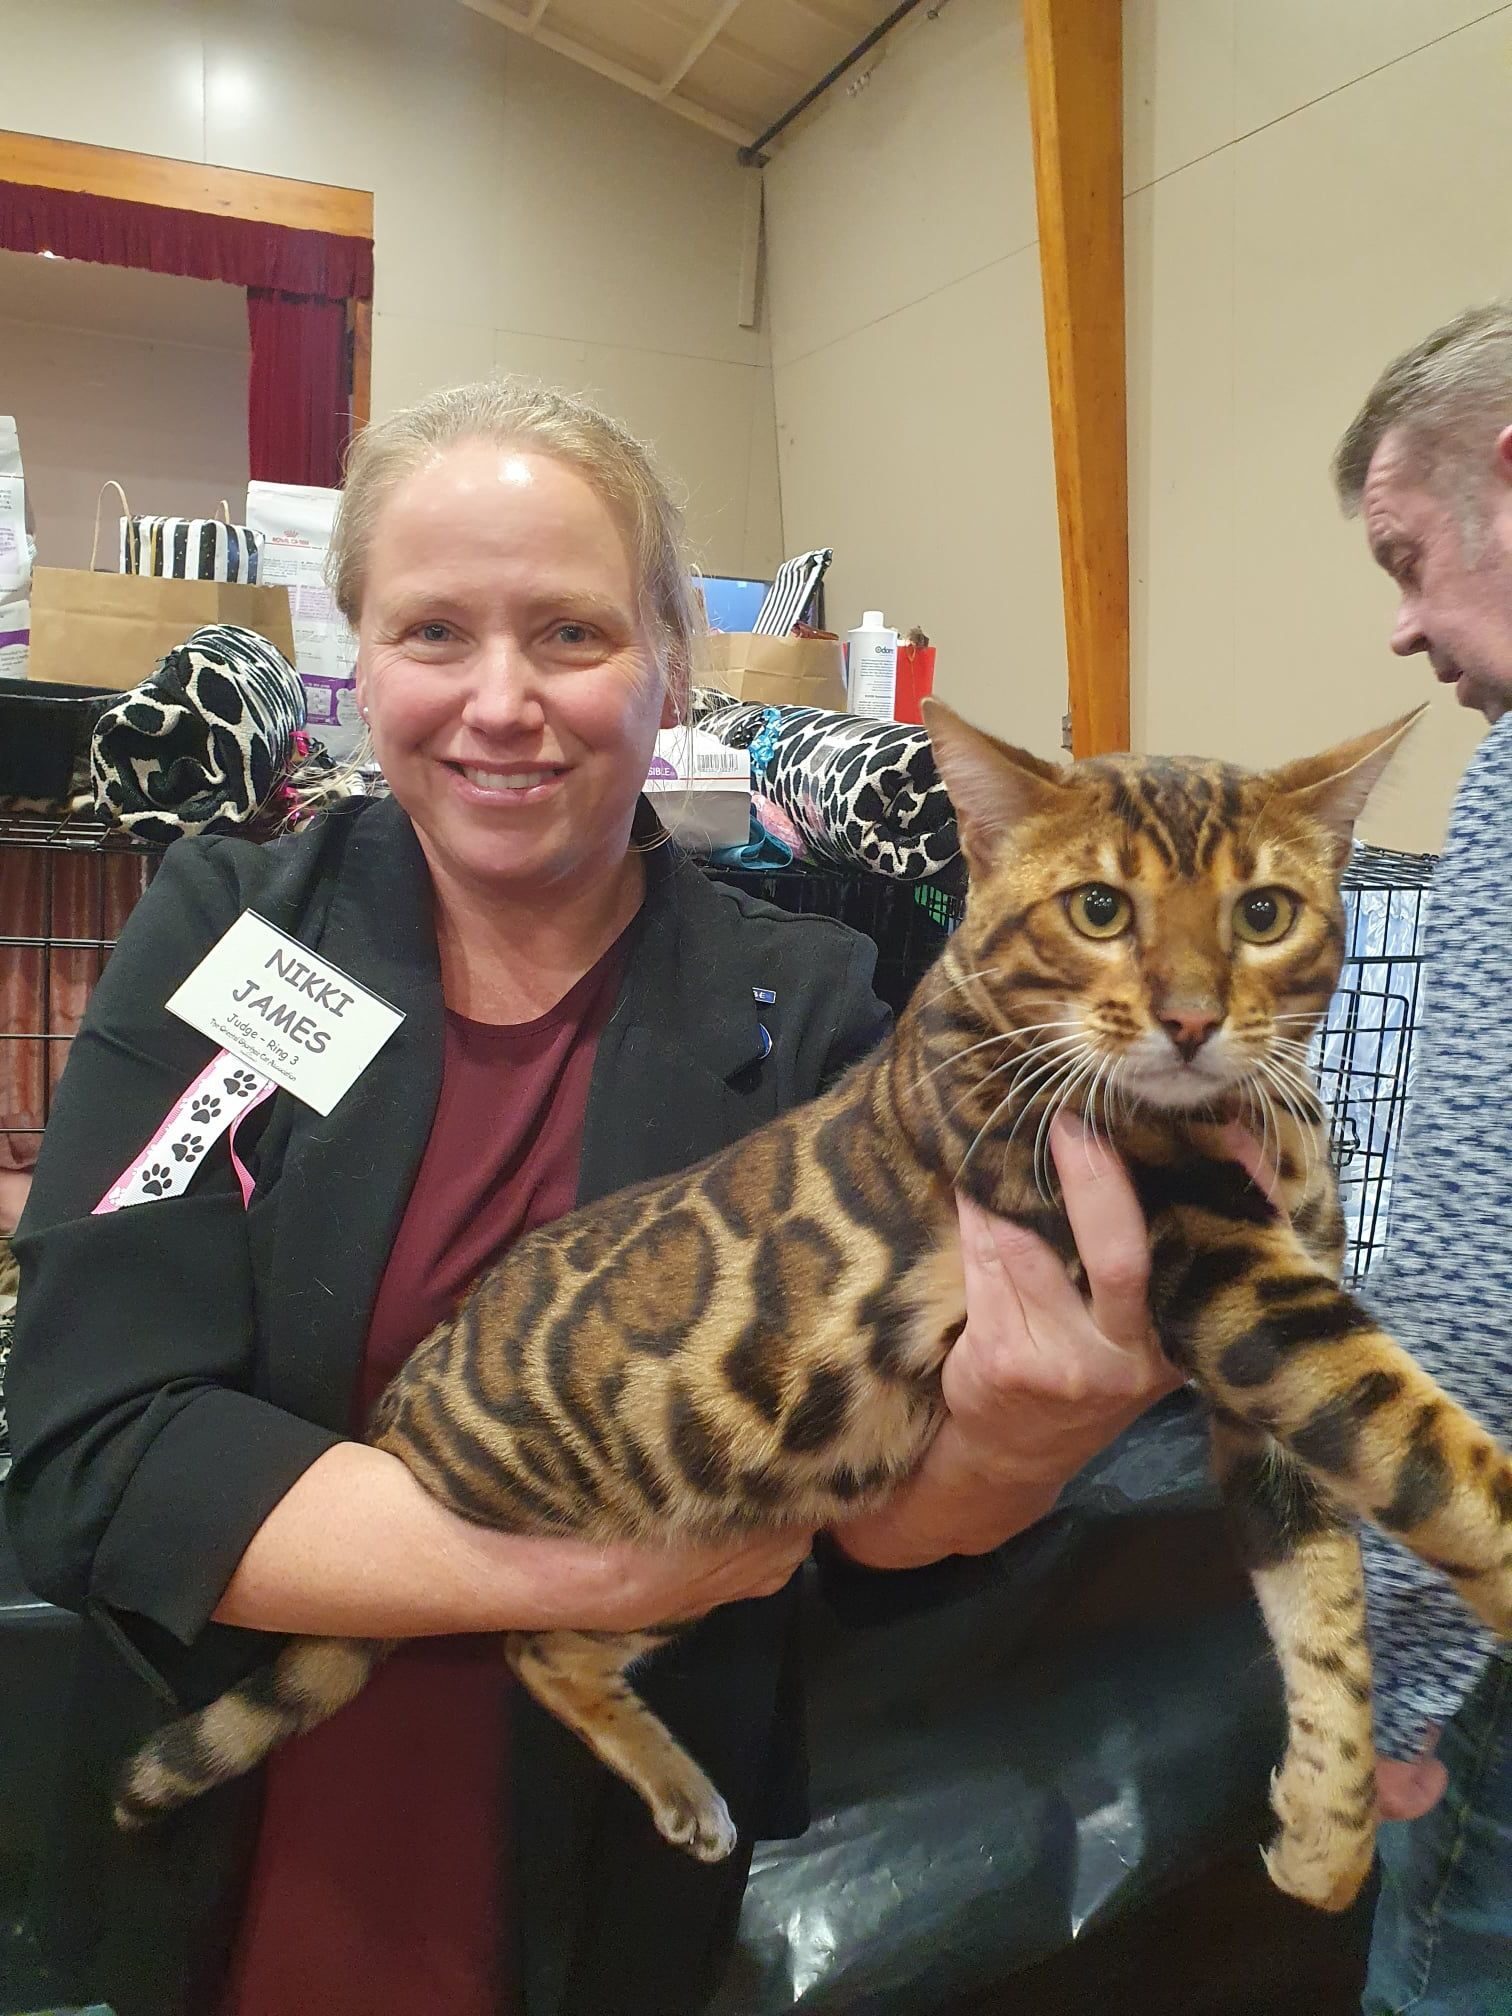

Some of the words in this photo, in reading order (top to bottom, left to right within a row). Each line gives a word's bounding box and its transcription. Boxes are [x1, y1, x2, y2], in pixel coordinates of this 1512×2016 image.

[231, 979, 332, 1054] JAMES
[264, 948, 354, 1018] NIKKI
[226, 1013, 258, 1039] Judge
[266, 1039, 289, 1062] Ring
[289, 1055, 300, 1065] 3
